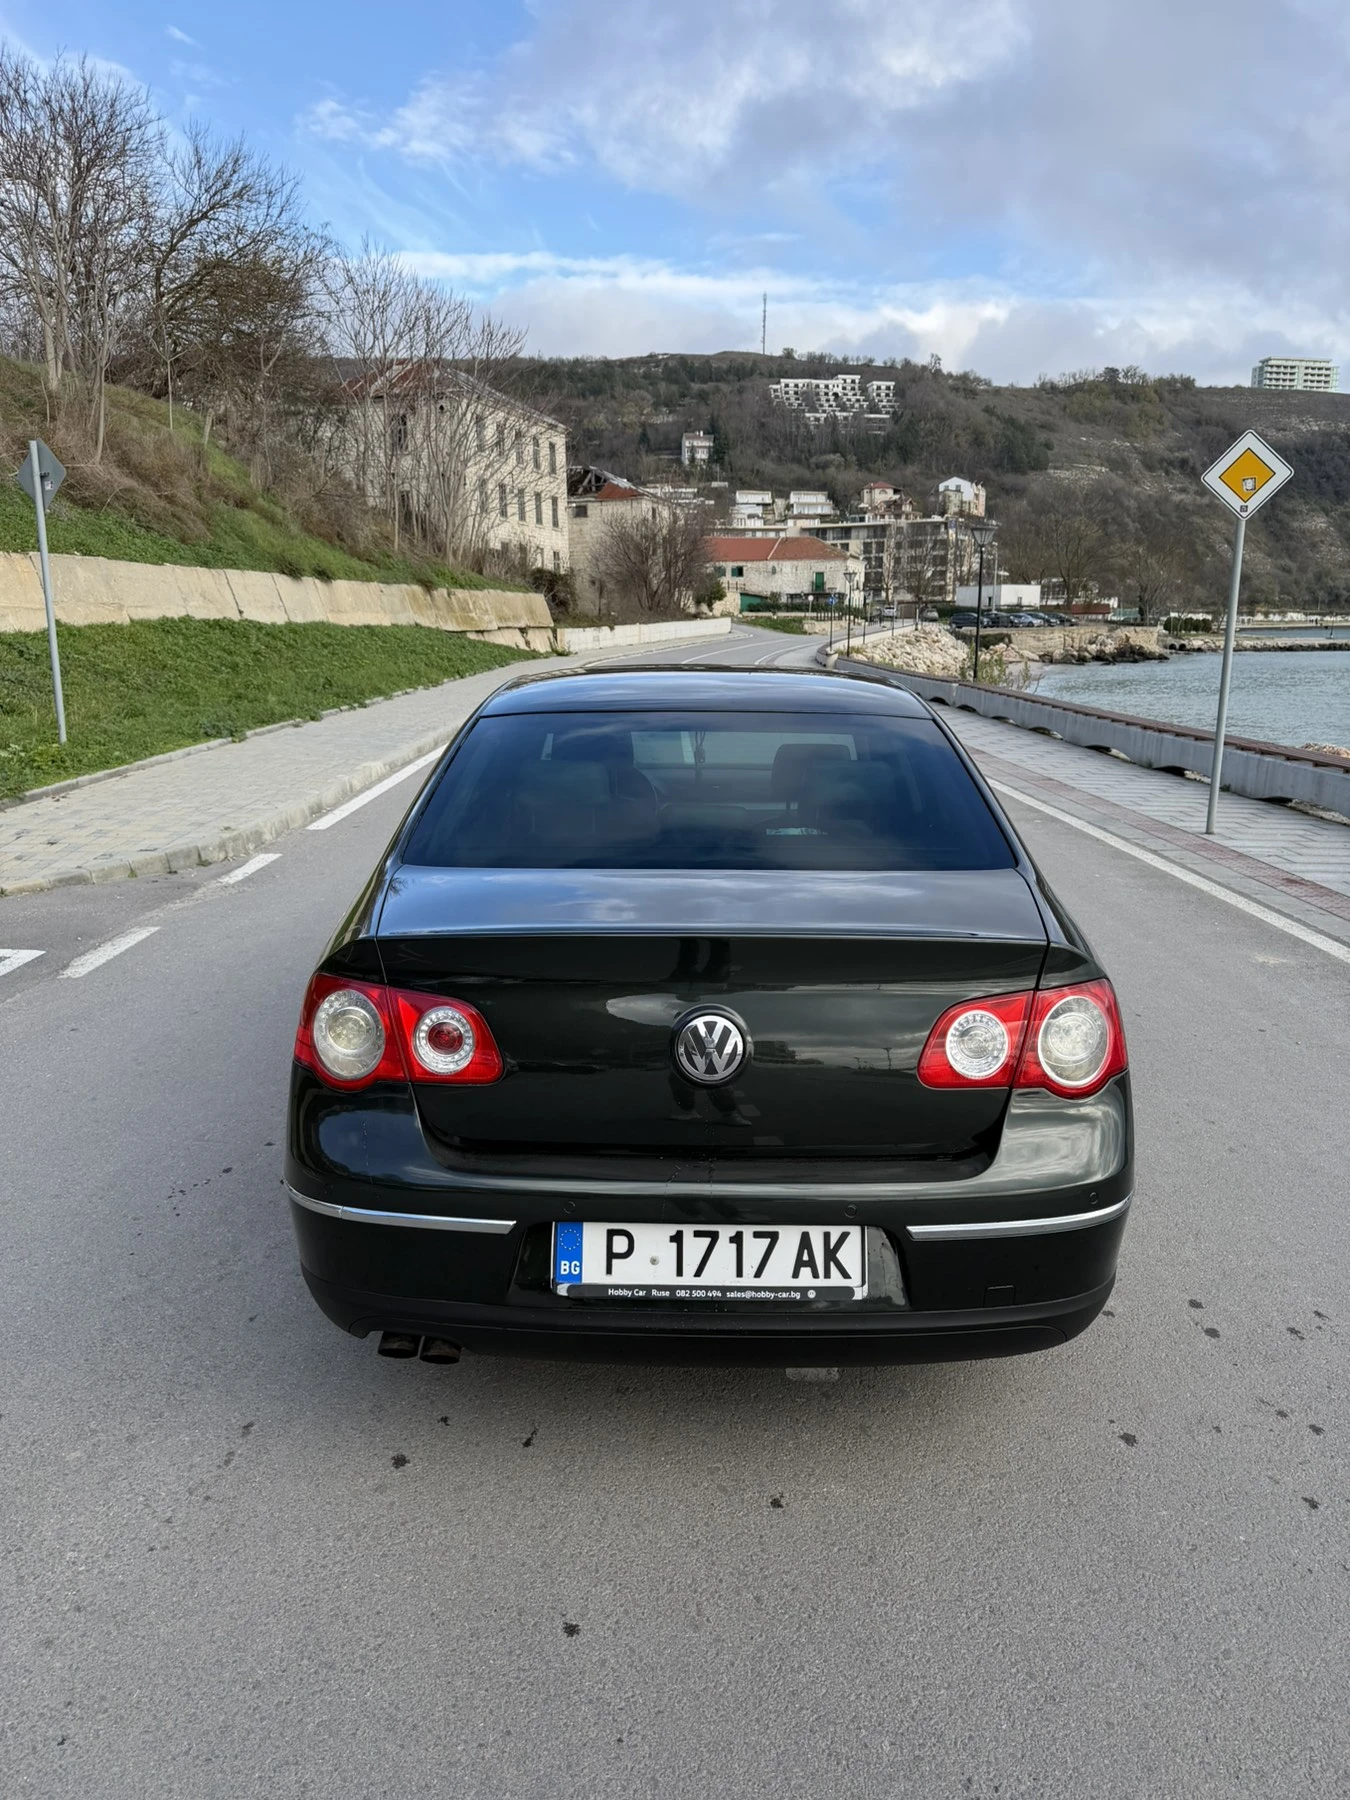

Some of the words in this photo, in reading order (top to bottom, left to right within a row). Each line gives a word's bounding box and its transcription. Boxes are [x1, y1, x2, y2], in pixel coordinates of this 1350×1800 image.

[677, 1014, 744, 1081] VW
[560, 1260, 580, 1275] BG
[605, 1228, 635, 1275] P
[669, 1230, 780, 1278] 1717
[791, 1231, 853, 1280] AK
[608, 1288, 633, 1298] Hobby
[633, 1288, 647, 1296] Car
[651, 1289, 670, 1297] Ruse
[675, 1289, 691, 1297] 082
[691, 1290, 706, 1298] 500
[707, 1290, 722, 1298] 494
[726, 1290, 801, 1300] sales@hobby-car.bg
